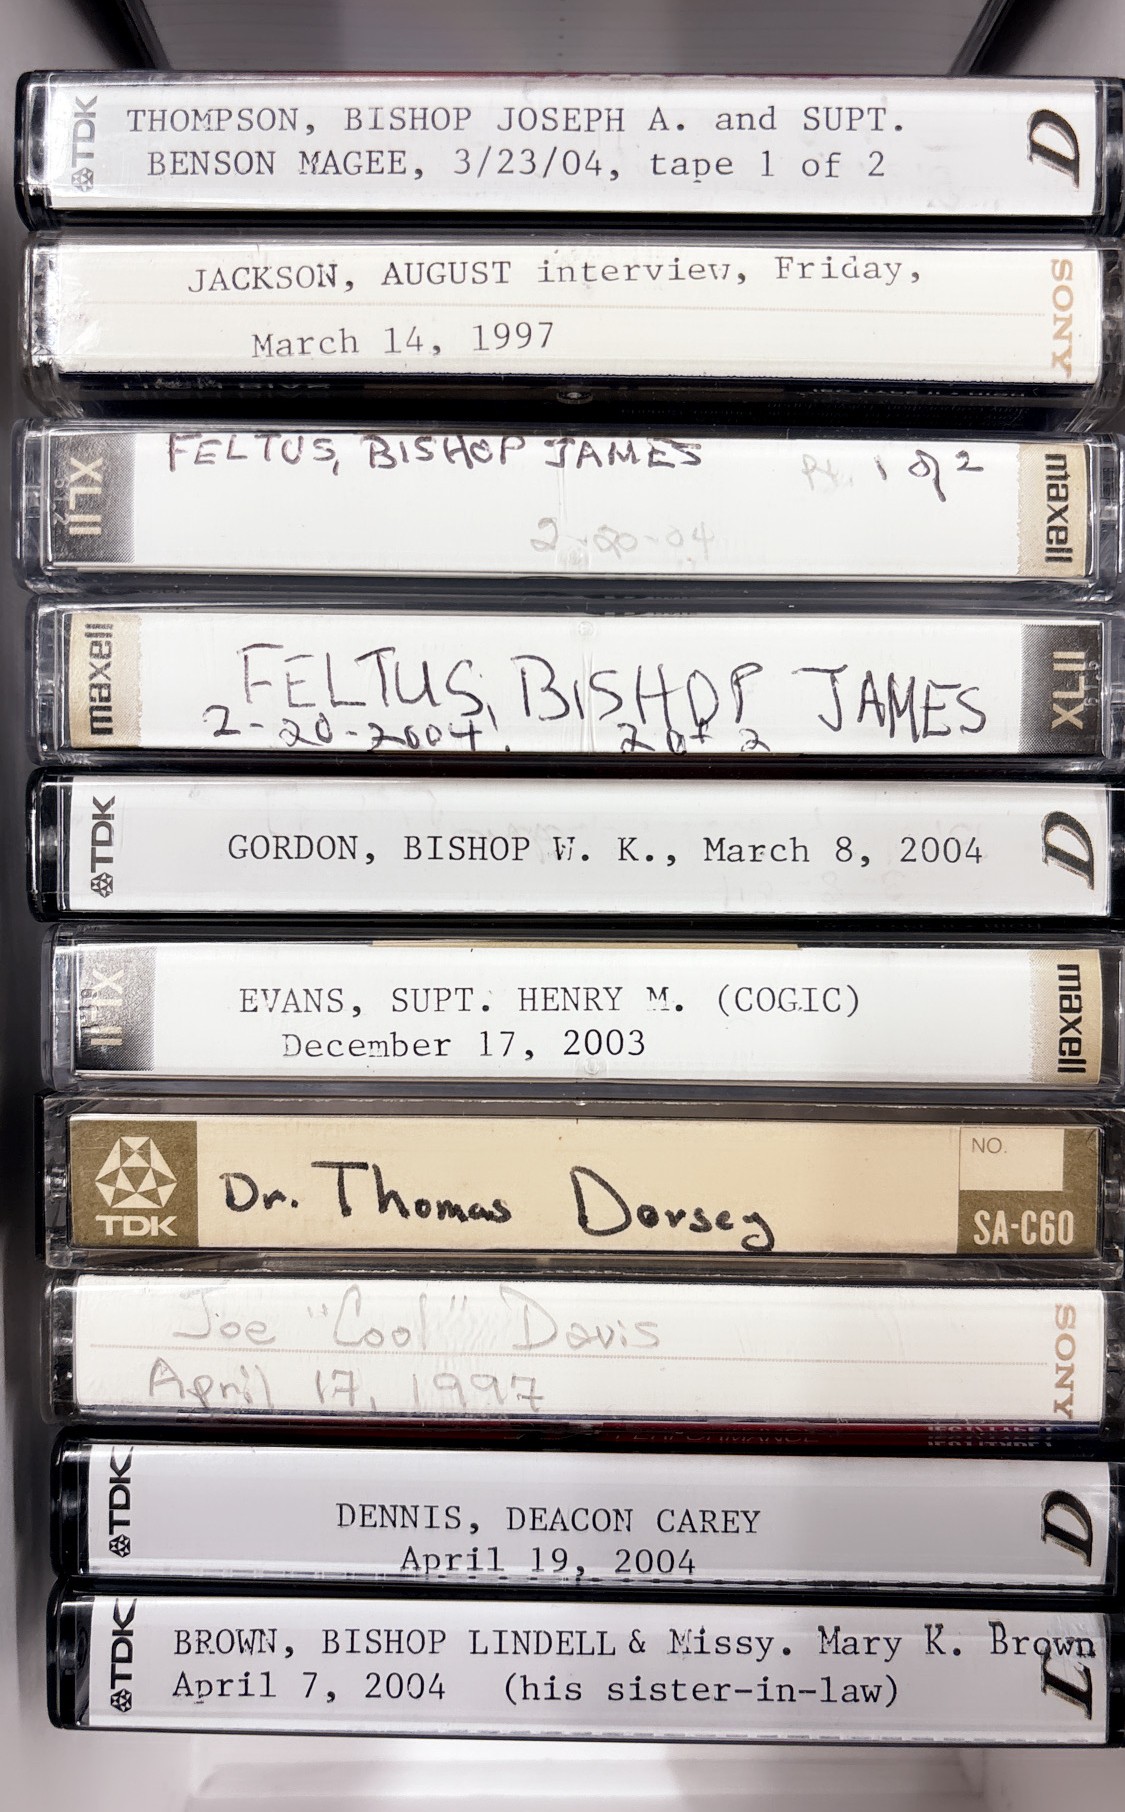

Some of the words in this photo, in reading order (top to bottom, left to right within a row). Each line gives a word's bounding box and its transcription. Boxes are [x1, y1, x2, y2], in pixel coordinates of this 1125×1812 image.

[71, 95, 98, 167] TDK
[126, 107, 315, 136] THOMPSON,
[344, 106, 472, 131] BISHOP
[496, 107, 625, 133] JOSEPH
[647, 106, 685, 132] A.
[715, 105, 777, 131] and
[803, 106, 903, 132] SUPT.
[147, 150, 276, 176] BENSON
[298, 149, 424, 181] MAGEE,
[454, 145, 619, 182] 3/23/04,
[650, 153, 734, 184] tape
[761, 150, 774, 177] 1
[801, 151, 842, 178] of
[868, 150, 885, 177] 2
[1027, 108, 1081, 189] D
[187, 263, 354, 293] JACKSON,
[380, 260, 511, 286] AUGUST
[537, 257, 746, 285] interview,
[774, 255, 920, 287] Friday,
[251, 327, 360, 358] March
[384, 325, 441, 357] 14,
[473, 321, 554, 351] 1997
[1051, 256, 1075, 377] SONY
[166, 434, 341, 476] FELTUS,
[362, 435, 525, 470] BISHOP
[544, 438, 702, 469] JAMES
[873, 452, 888, 481] 1
[955, 450, 984, 472] 2
[1044, 452, 1073, 565] maxell
[84, 623, 114, 736] maxell
[237, 643, 496, 729] FELTUS,
[791, 664, 986, 743] JAMES
[1050, 651, 1086, 733] XLII
[620, 723, 655, 753] 2
[740, 729, 771, 752] 2
[90, 795, 116, 874] TDK
[228, 834, 375, 866] GORDON,
[403, 835, 530, 861] BISHOP
[552, 836, 590, 862] W.
[617, 837, 676, 867] K.,
[702, 836, 810, 863] March
[835, 835, 870, 868] 8,
[900, 836, 983, 865] 2004
[1041, 810, 1095, 891] D
[239, 987, 362, 1018] EVANS,
[389, 986, 491, 1015] SUPT.
[517, 986, 624, 1012] HENRY
[646, 986, 684, 1013] M.
[718, 983, 859, 1018] (COGIC)
[1056, 963, 1087, 1073] maxell
[281, 1031, 452, 1058] December
[480, 1030, 534, 1061] 17,
[563, 1028, 645, 1056] 2003
[971, 1138, 1007, 1154] NO.
[96, 1215, 178, 1236] TDK
[219, 1171, 299, 1212] Dr.
[311, 1161, 512, 1224] Thomas
[570, 1166, 774, 1252] Dorsey
[973, 1209, 1073, 1245] SA-C60
[173, 1281, 277, 1345] Joe
[307, 1284, 468, 1348] "Cool"
[500, 1286, 661, 1349] Davis
[149, 1357, 274, 1408] April
[314, 1369, 376, 1408] 17,
[413, 1372, 546, 1410] 1997
[1053, 1303, 1076, 1420] SONY
[109, 1445, 134, 1535] TDK
[335, 1502, 479, 1535] DENNIS,
[506, 1506, 634, 1533] DEACON
[656, 1508, 761, 1534] CAREY
[1040, 1489, 1094, 1568] D
[399, 1545, 504, 1573] April
[530, 1547, 586, 1577] 19,
[614, 1548, 696, 1575] 2004
[110, 1597, 137, 1689] TDK
[173, 1628, 294, 1659] BROWN,
[321, 1628, 446, 1655] BISHOP
[468, 1629, 616, 1656] LINDELL
[628, 1628, 646, 1654] &
[668, 1625, 792, 1663] Missy.
[817, 1625, 903, 1663] Mary
[923, 1622, 962, 1657] K.
[987, 1620, 1097, 1659] Brown
[172, 1670, 277, 1705] April
[302, 1671, 336, 1704] 7,
[365, 1672, 446, 1700] 2004
[505, 1672, 582, 1706] (his
[607, 1674, 898, 1709] sister-in-law)
